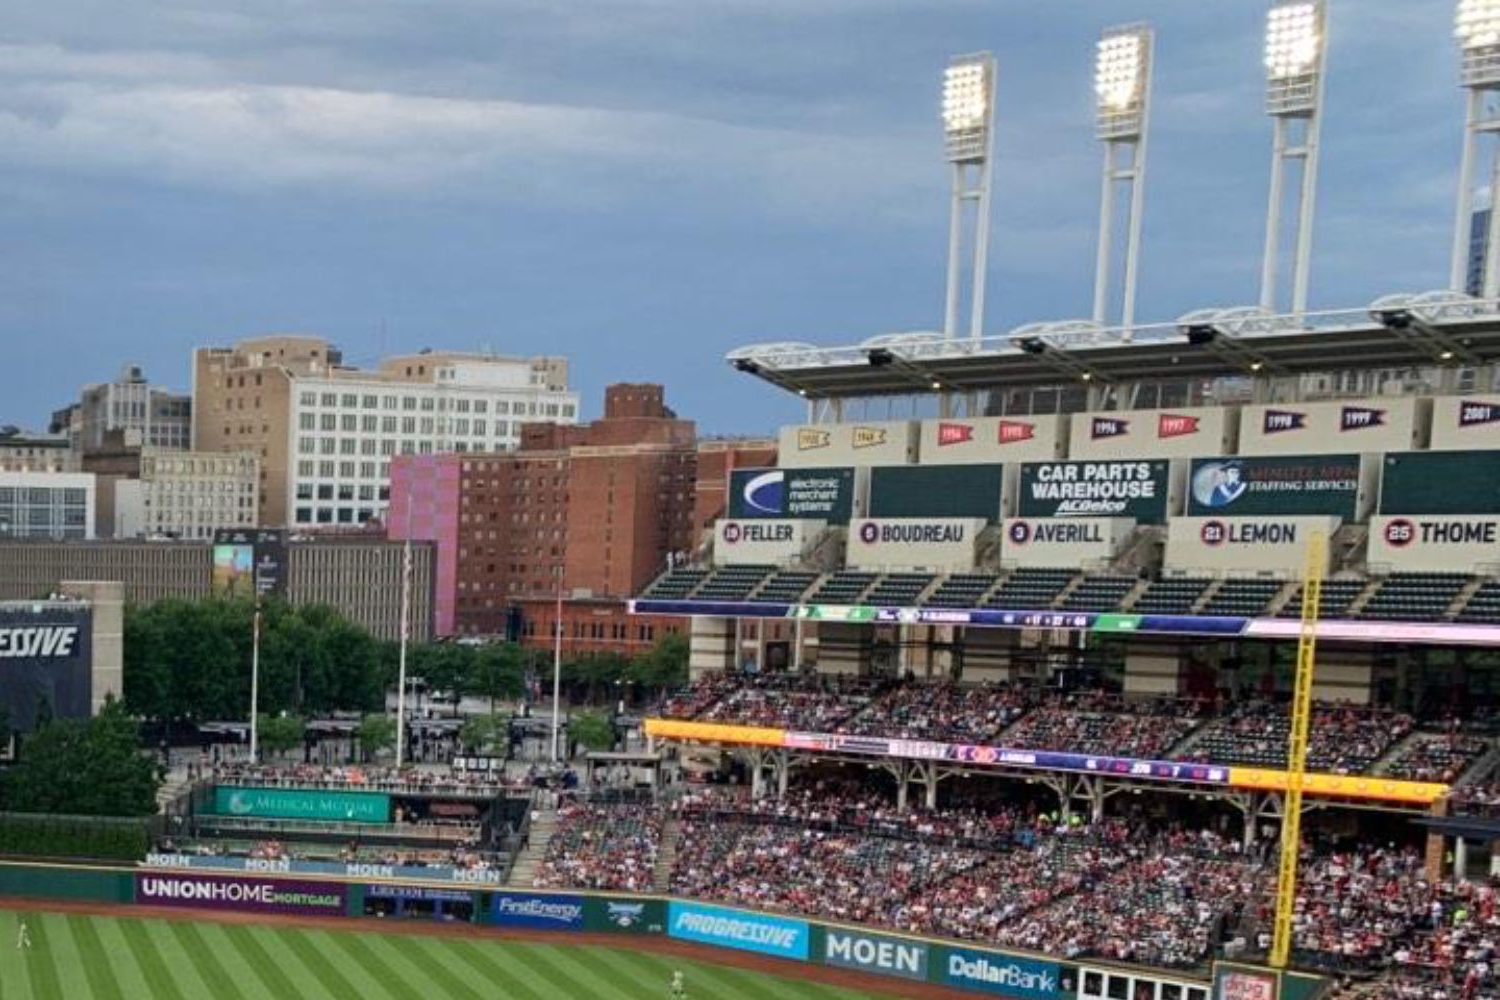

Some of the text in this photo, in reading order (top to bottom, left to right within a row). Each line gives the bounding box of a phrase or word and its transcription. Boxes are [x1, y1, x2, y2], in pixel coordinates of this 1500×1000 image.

[1037, 463, 1151, 482] CAR PARTS
[1031, 481, 1156, 499] WAREHOUSE
[1056, 500, 1128, 513] ACDelco
[742, 523, 794, 543] FELLER
[881, 523, 964, 543] BOUDREAU
[1032, 524, 1104, 544] AVERILL
[1204, 522, 1297, 544] 21 LEMON
[1388, 522, 1498, 543] 25 THOME
[146, 852, 191, 868] MOEN
[244, 857, 291, 873] MOEN
[345, 861, 394, 878] MOEN
[452, 866, 501, 883] MOEN
[675, 911, 800, 949] PROGRESSIVE
[825, 933, 920, 972] MOEN
[949, 955, 1056, 993] DollarBank
